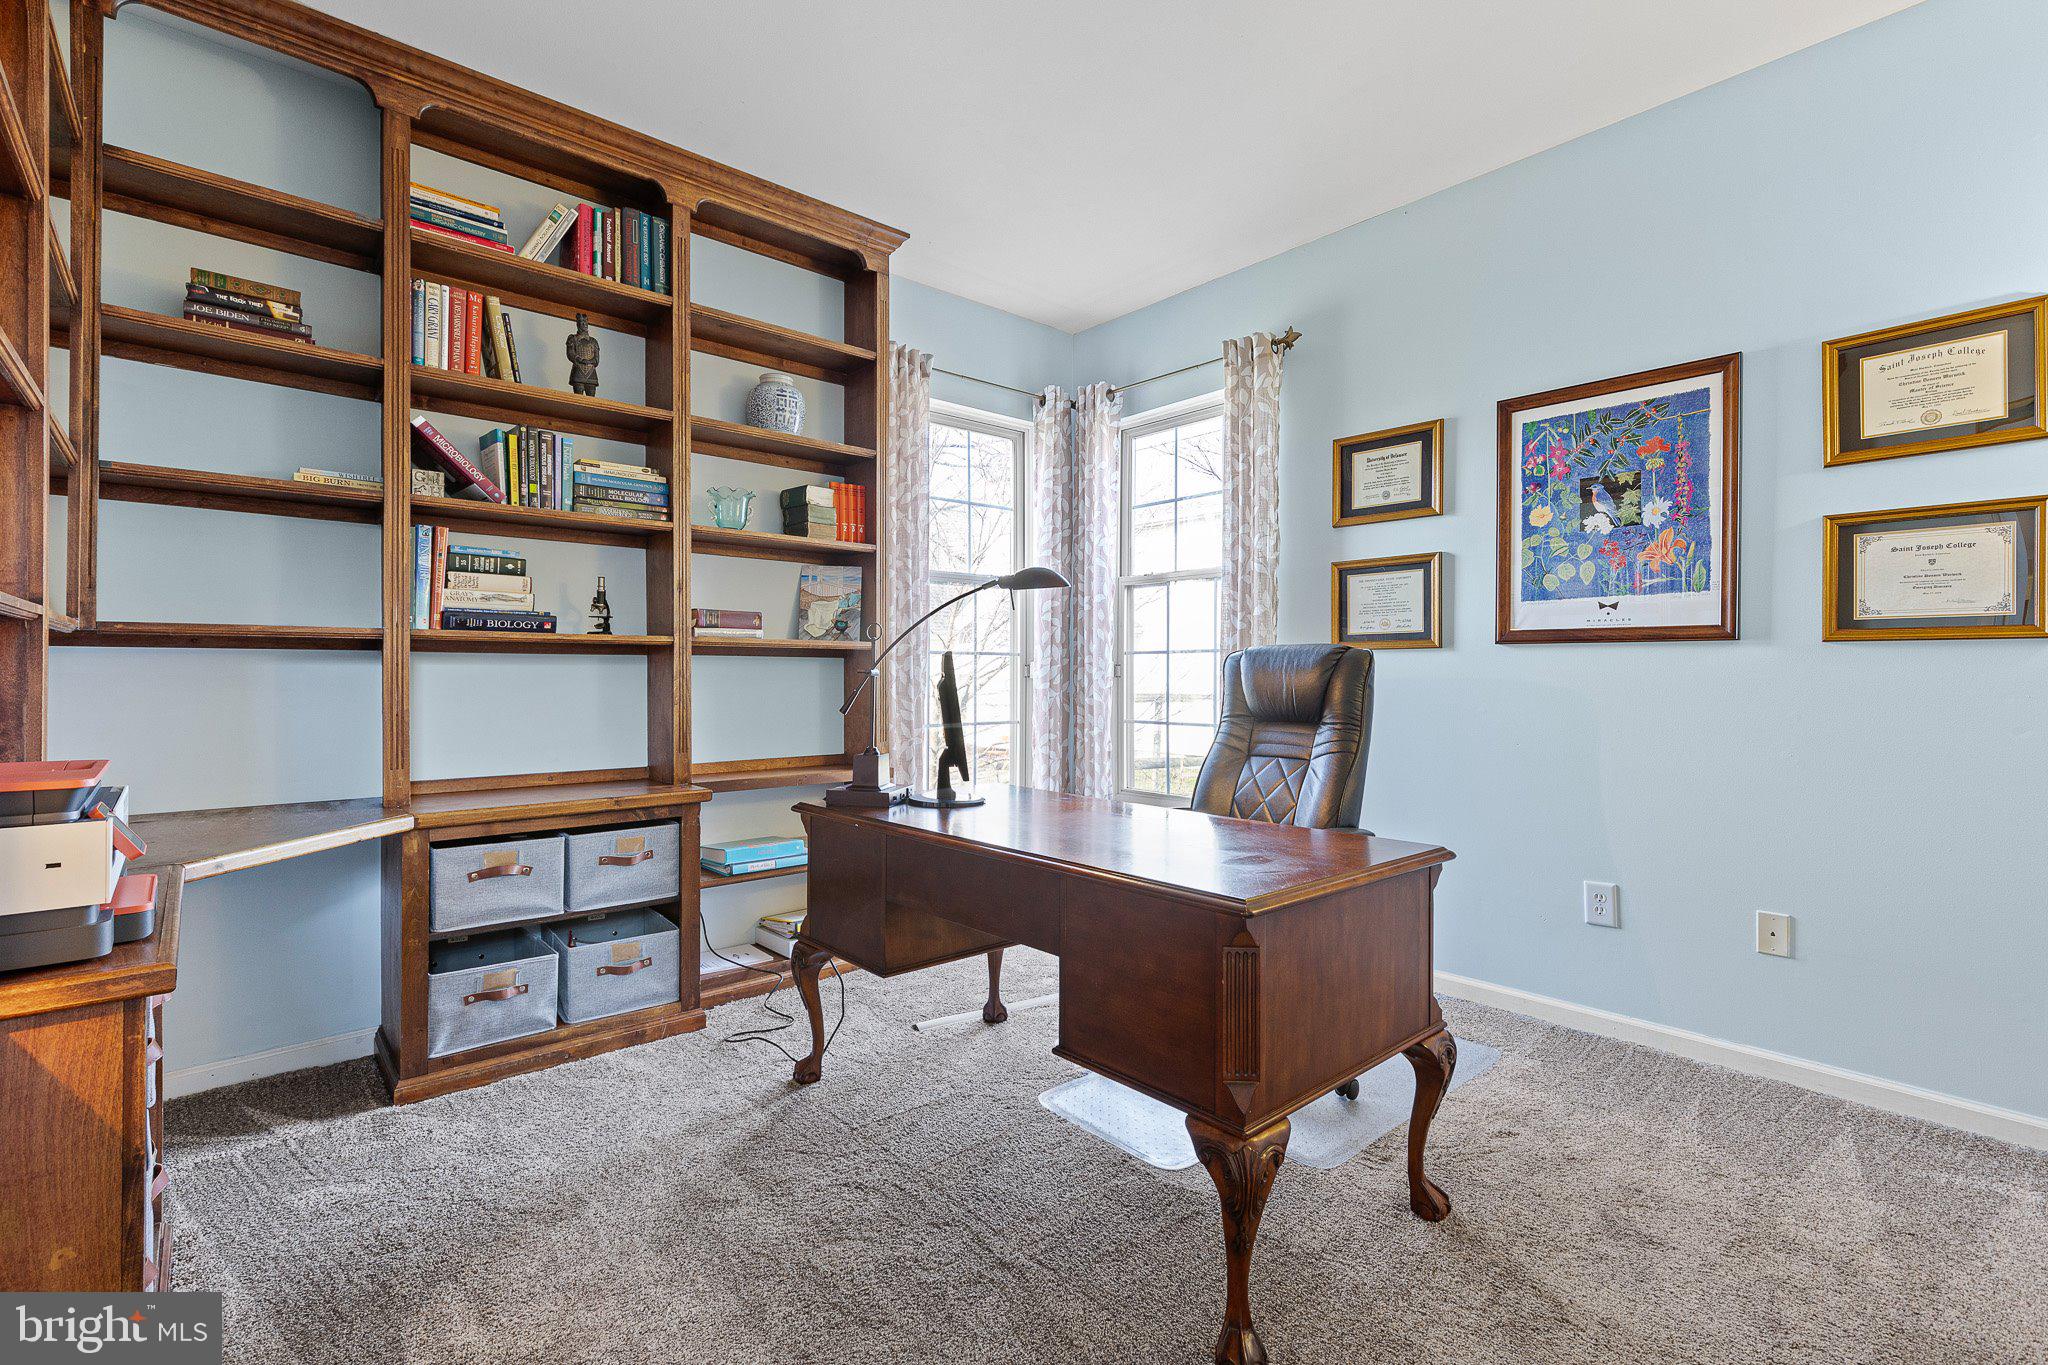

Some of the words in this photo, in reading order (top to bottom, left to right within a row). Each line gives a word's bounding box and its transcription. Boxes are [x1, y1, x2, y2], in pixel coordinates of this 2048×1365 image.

[427, 297, 439, 316] CARY
[469, 293, 482, 304] Me
[191, 303, 213, 315] JOE
[215, 307, 250, 322] BIDEN
[427, 316, 439, 341] GRANT
[470, 335, 479, 364] Hepburn
[1878, 358, 1904, 373] Saint
[1907, 350, 1943, 364] Joseph
[1947, 346, 1987, 356] College
[433, 434, 486, 482] MICROBIOLOGY
[302, 474, 320, 483] BIG
[323, 477, 352, 487] BURN
[608, 489, 644, 497] MOLECULAR
[1915, 544, 1944, 552] Joseph
[486, 619, 539, 630] BIOLOGY
